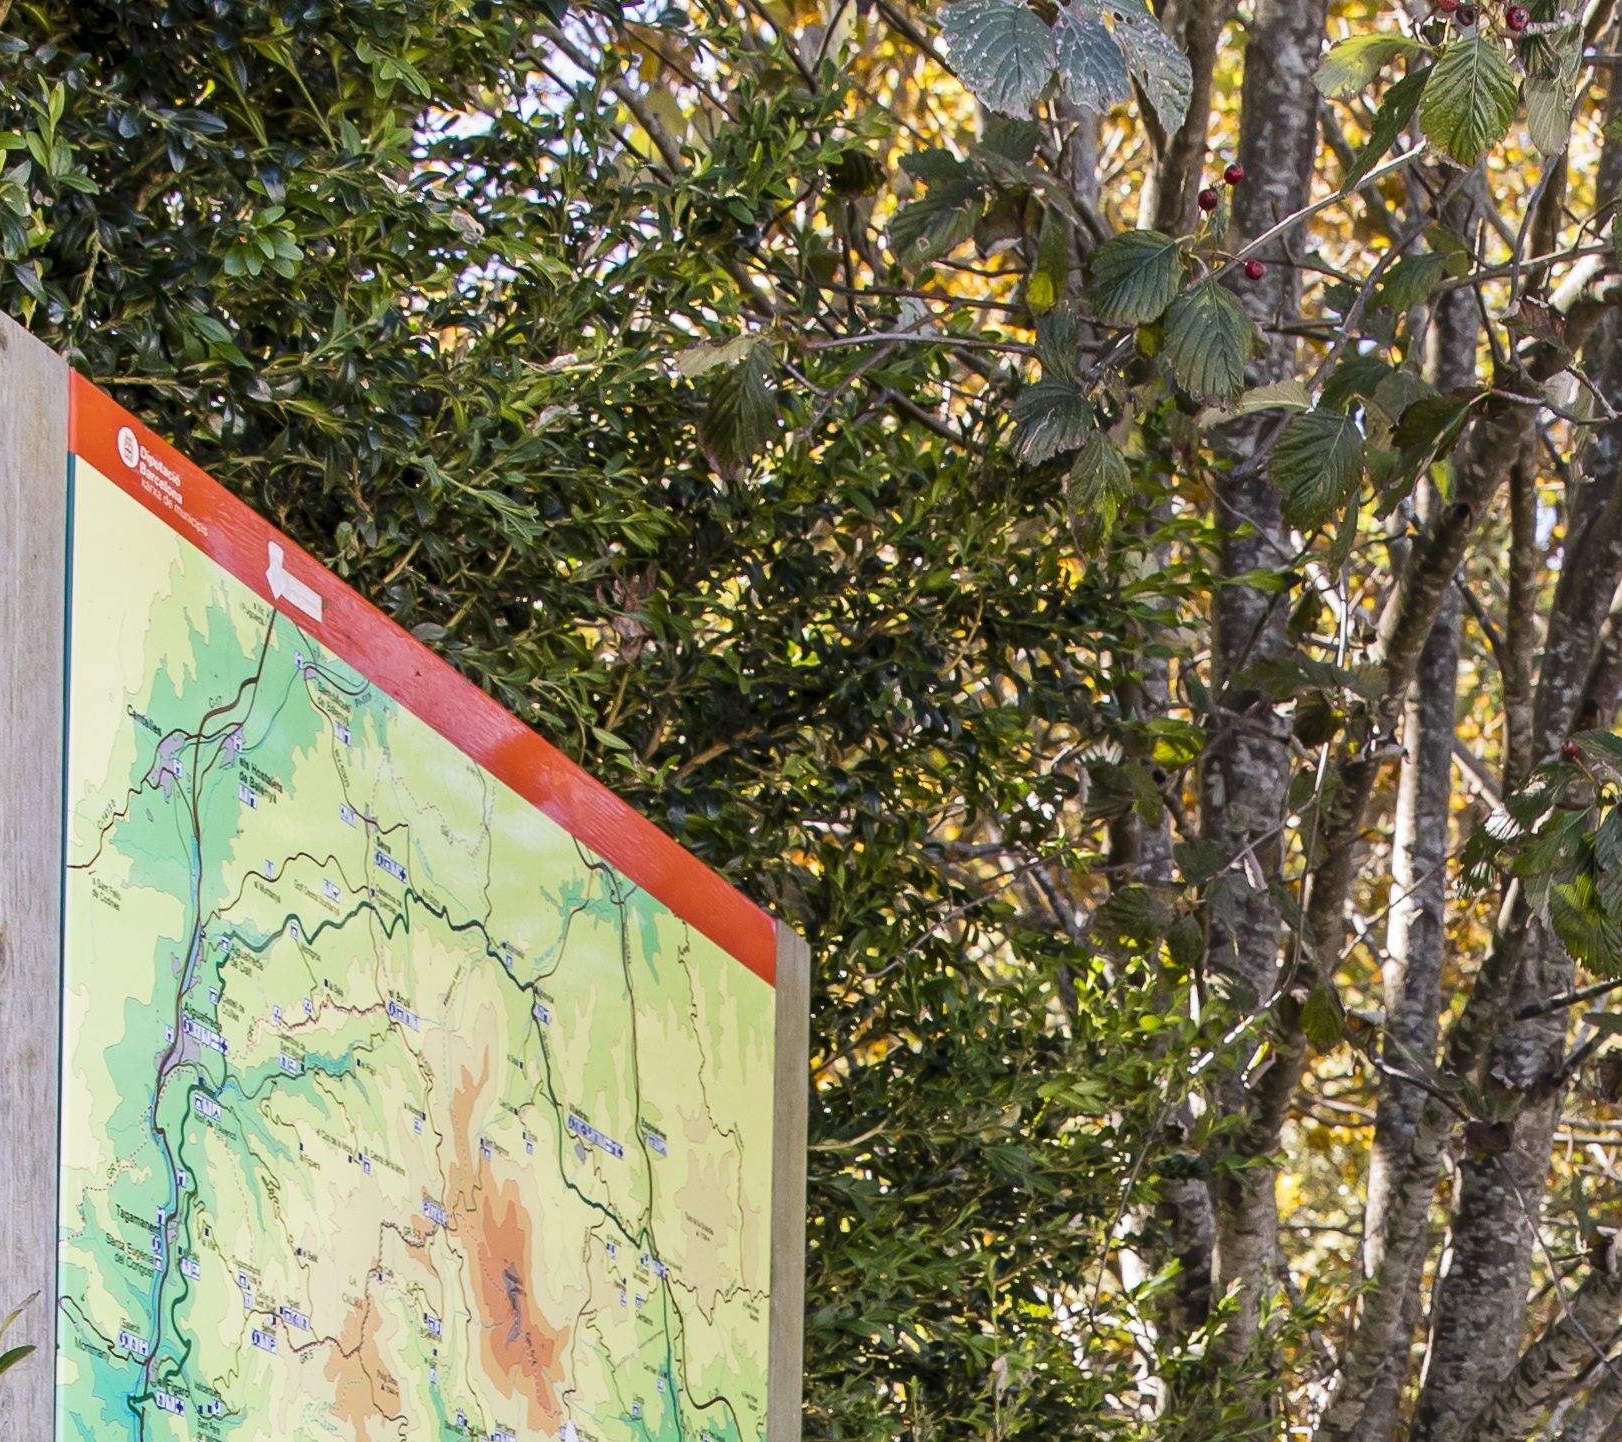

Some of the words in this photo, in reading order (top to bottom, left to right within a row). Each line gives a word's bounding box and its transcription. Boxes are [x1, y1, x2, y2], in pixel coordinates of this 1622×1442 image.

[140, 445, 180, 486] Diputació
[140, 461, 183, 505] Barcelona
[163, 495, 173, 509] de
[174, 504, 208, 536] municipis
[128, 704, 162, 737] Centelles
[251, 763, 283, 793] Hostalets
[183, 1003, 223, 1033] Aiguafreda
